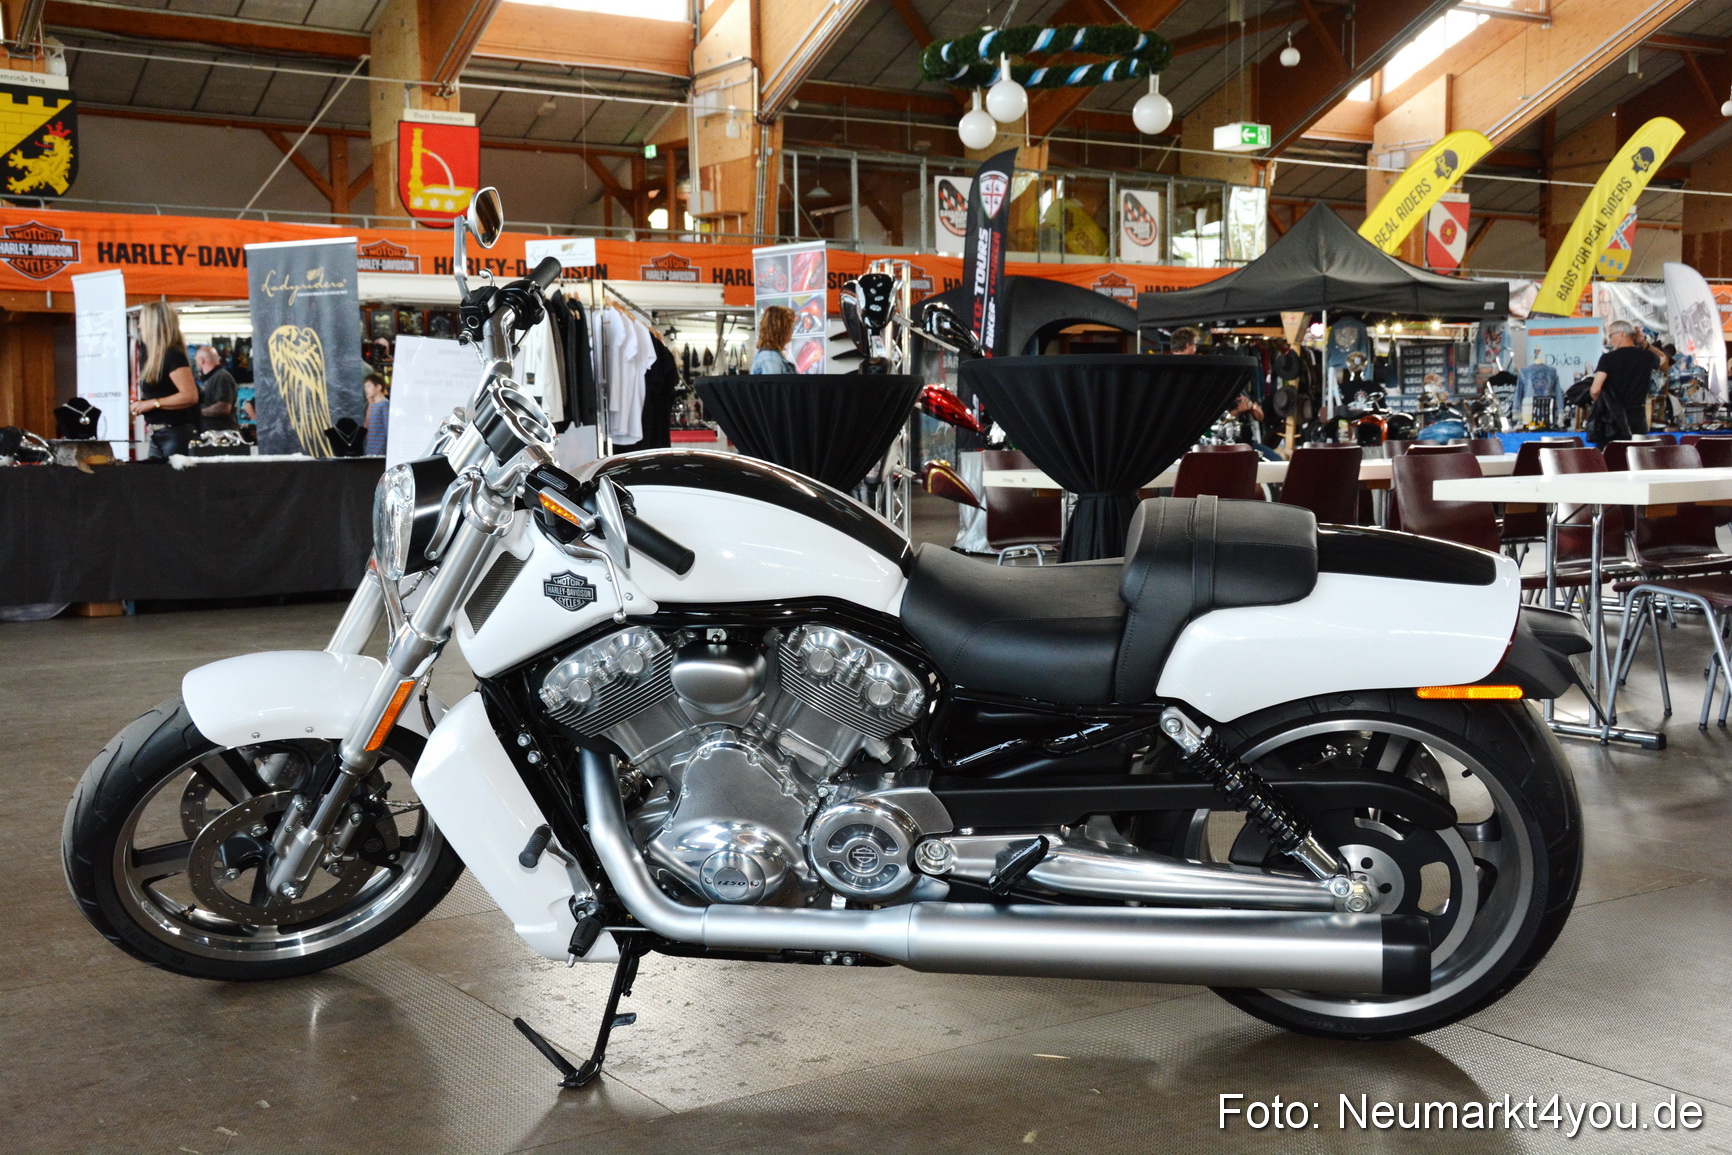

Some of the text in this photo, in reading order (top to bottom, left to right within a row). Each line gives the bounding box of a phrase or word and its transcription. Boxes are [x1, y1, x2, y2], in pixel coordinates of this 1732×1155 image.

[1374, 177, 1432, 250] REAL RIDERS
[14, 227, 60, 241] MOTOR
[1556, 269, 1578, 302] BAGS
[1572, 246, 1592, 272] FOR
[1584, 219, 1607, 247] REAL
[1600, 176, 1633, 220] RIDERS
[0, 241, 74, 258] HARLEY-DAVIDSON
[15, 258, 57, 276] CYCLES
[556, 576, 582, 587] MOTOR
[547, 585, 592, 598] HARLEY-DAVIDSON
[557, 597, 582, 608] CYCLES
